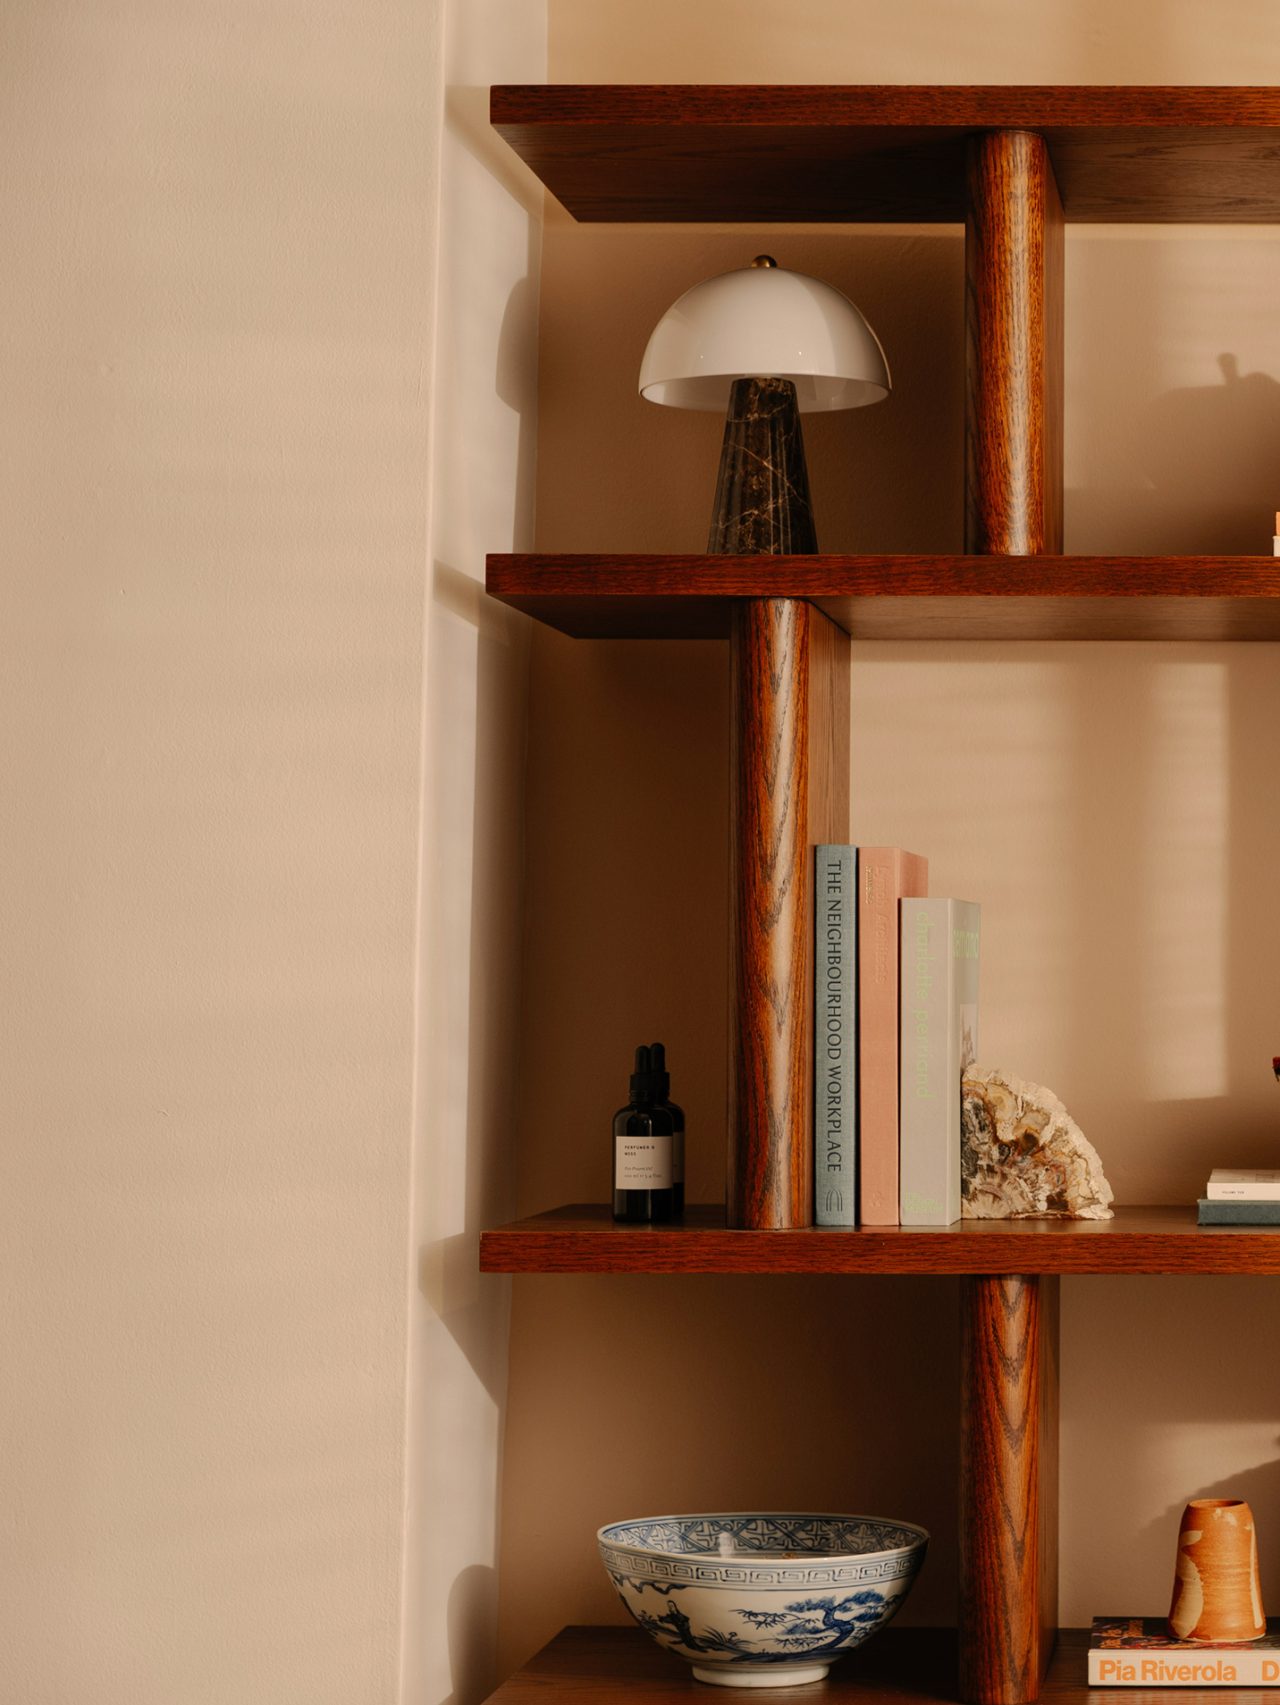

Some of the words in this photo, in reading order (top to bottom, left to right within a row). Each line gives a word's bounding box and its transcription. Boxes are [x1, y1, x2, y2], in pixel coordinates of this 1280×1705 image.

[827, 860, 842, 894] THE
[826, 900, 842, 1060] NEIGHBOURHOOD
[916, 912, 936, 998] charlotte
[912, 1008, 937, 1099] perriand
[827, 1065, 842, 1172] WORKPLACE
[1100, 1660, 1136, 1681] Pia
[1141, 1660, 1237, 1682] Riverola
